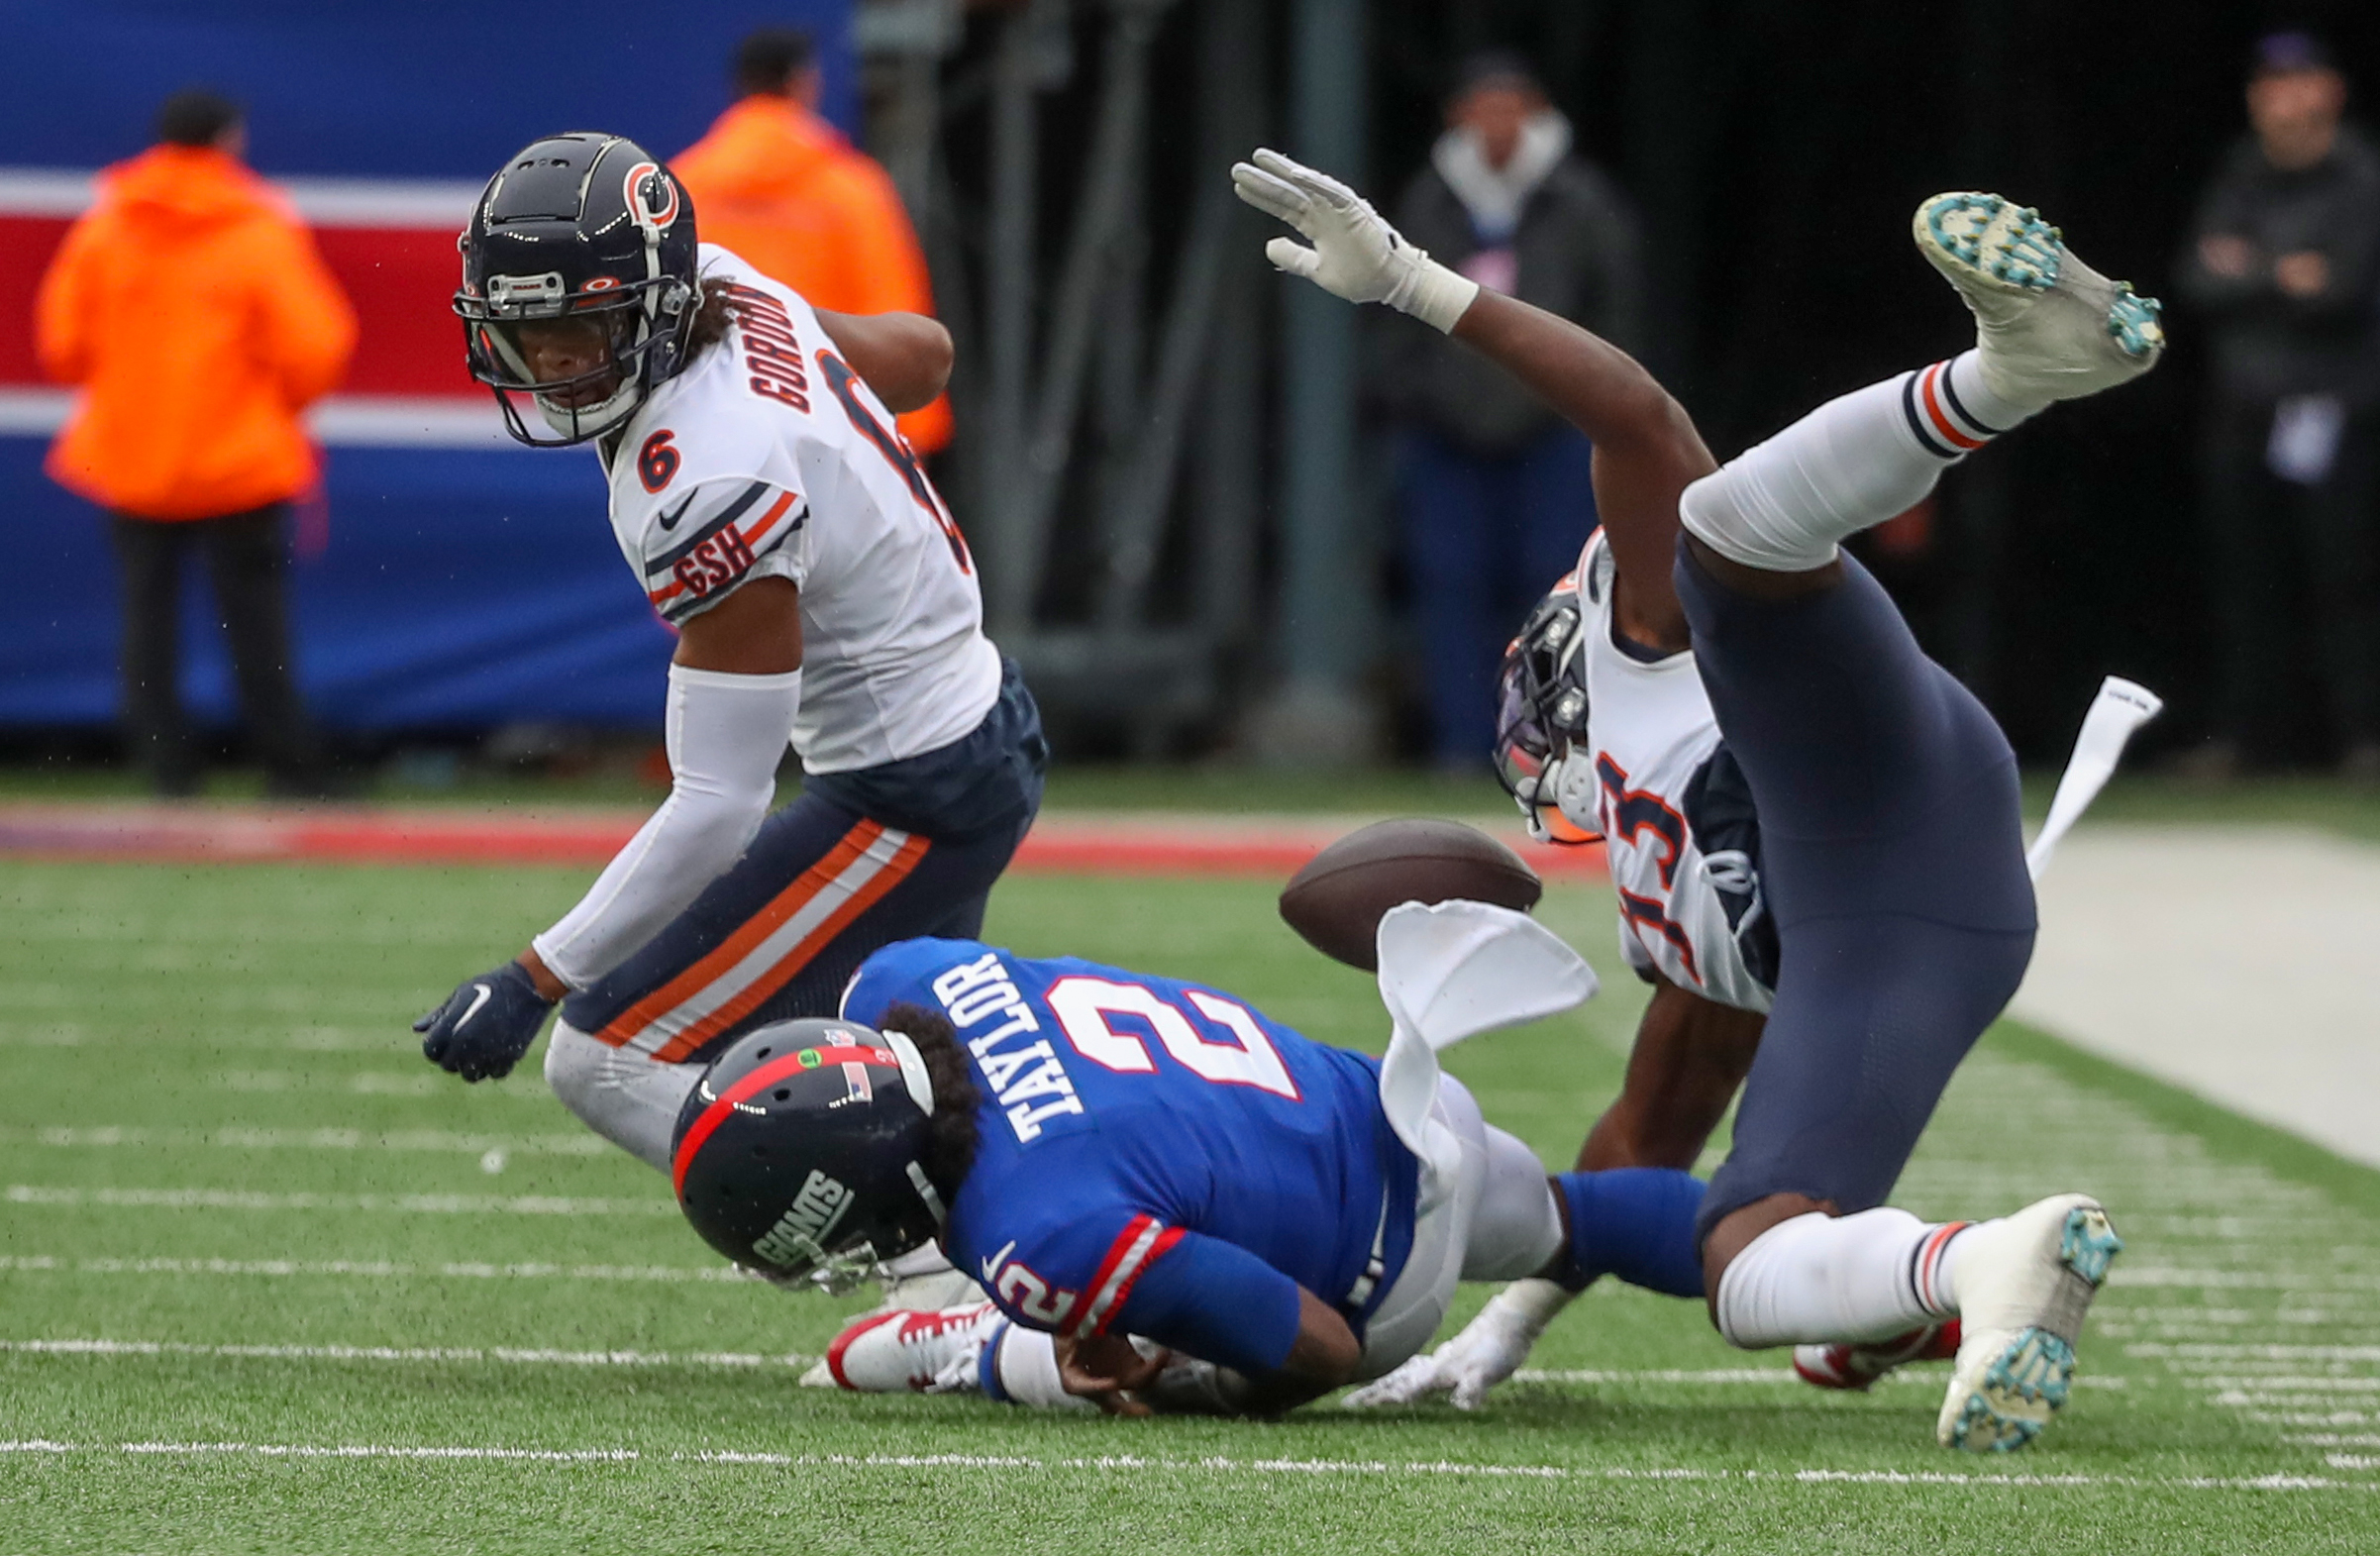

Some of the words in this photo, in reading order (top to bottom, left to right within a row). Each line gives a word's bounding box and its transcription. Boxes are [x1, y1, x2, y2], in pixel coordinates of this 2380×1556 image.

[726, 281, 811, 415] GORDON
[638, 429, 681, 494] 6
[673, 521, 757, 597] GSH
[932, 952, 1086, 1144] TAYLOR
[1043, 974, 1304, 1102] 2
[753, 1169, 845, 1266] GIANTS
[996, 1261, 1078, 1324] 2
